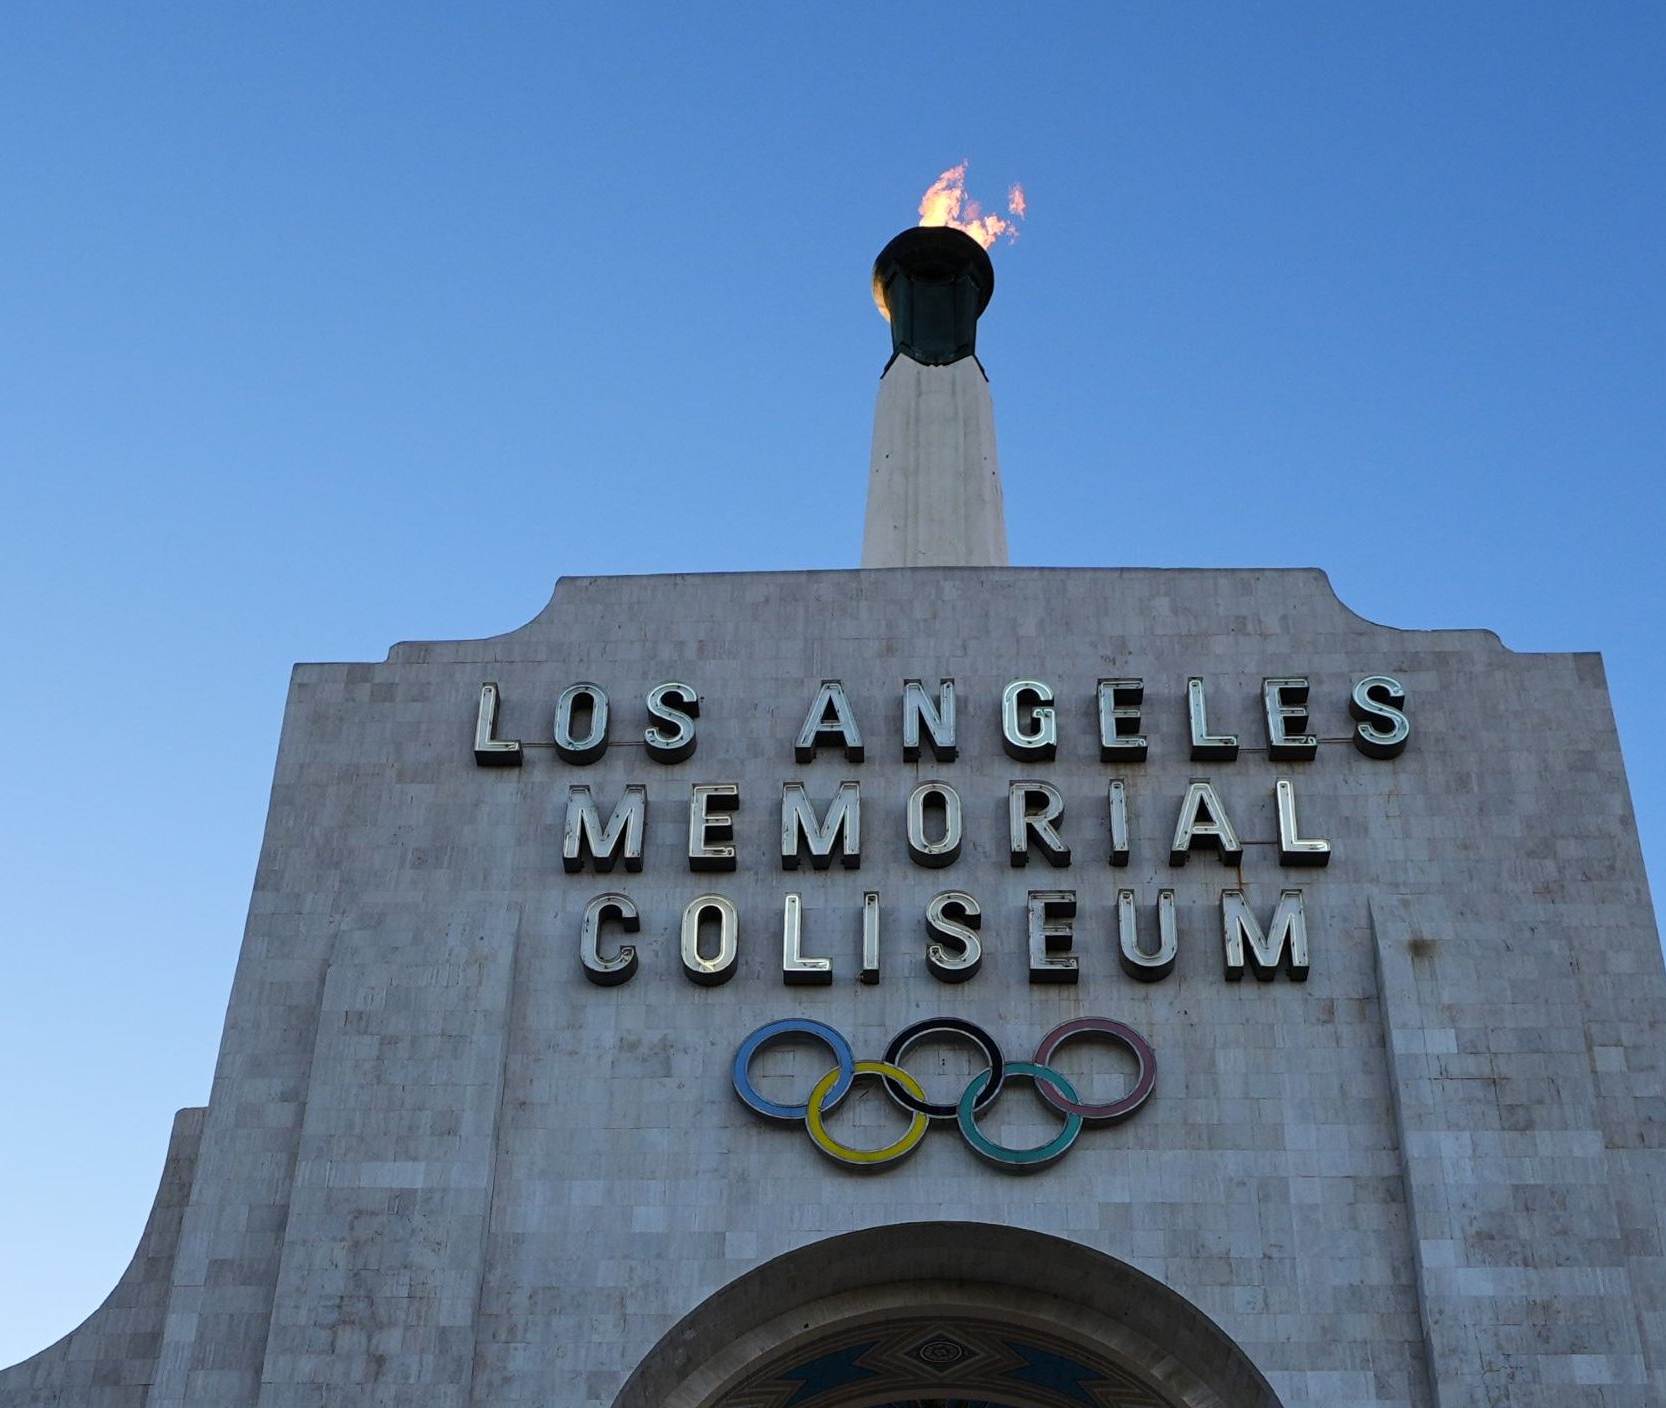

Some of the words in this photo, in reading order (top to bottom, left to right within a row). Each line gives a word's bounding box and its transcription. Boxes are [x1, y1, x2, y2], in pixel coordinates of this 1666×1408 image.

[473, 678, 700, 767] LOS
[794, 674, 1410, 764] ANGELES
[562, 778, 1332, 874] MEMORIAL
[579, 886, 1309, 987] COLISEUM
